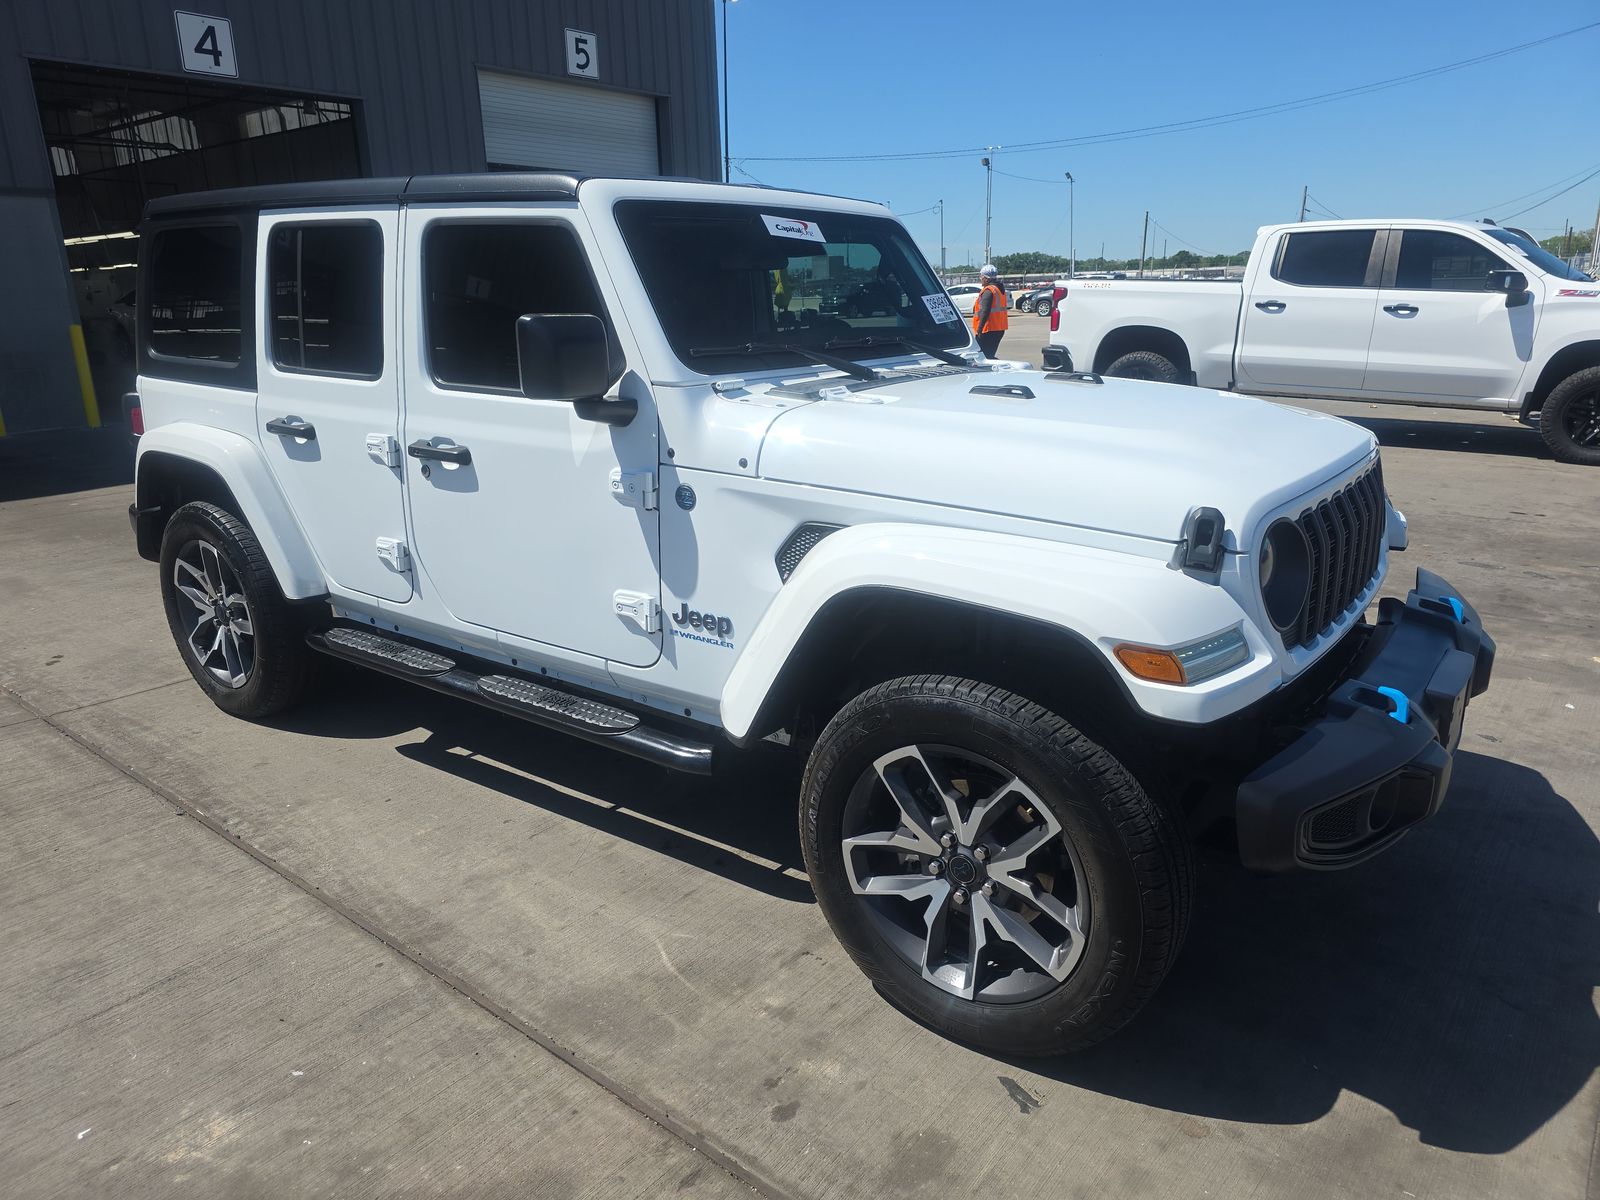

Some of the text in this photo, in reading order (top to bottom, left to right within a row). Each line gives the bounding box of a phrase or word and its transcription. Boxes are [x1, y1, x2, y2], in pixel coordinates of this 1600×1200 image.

[194, 25, 222, 67] 4
[575, 37, 590, 70] 5
[775, 223, 803, 233] Capital
[672, 602, 733, 638] Jeep
[679, 631, 734, 649] WRANGLER
